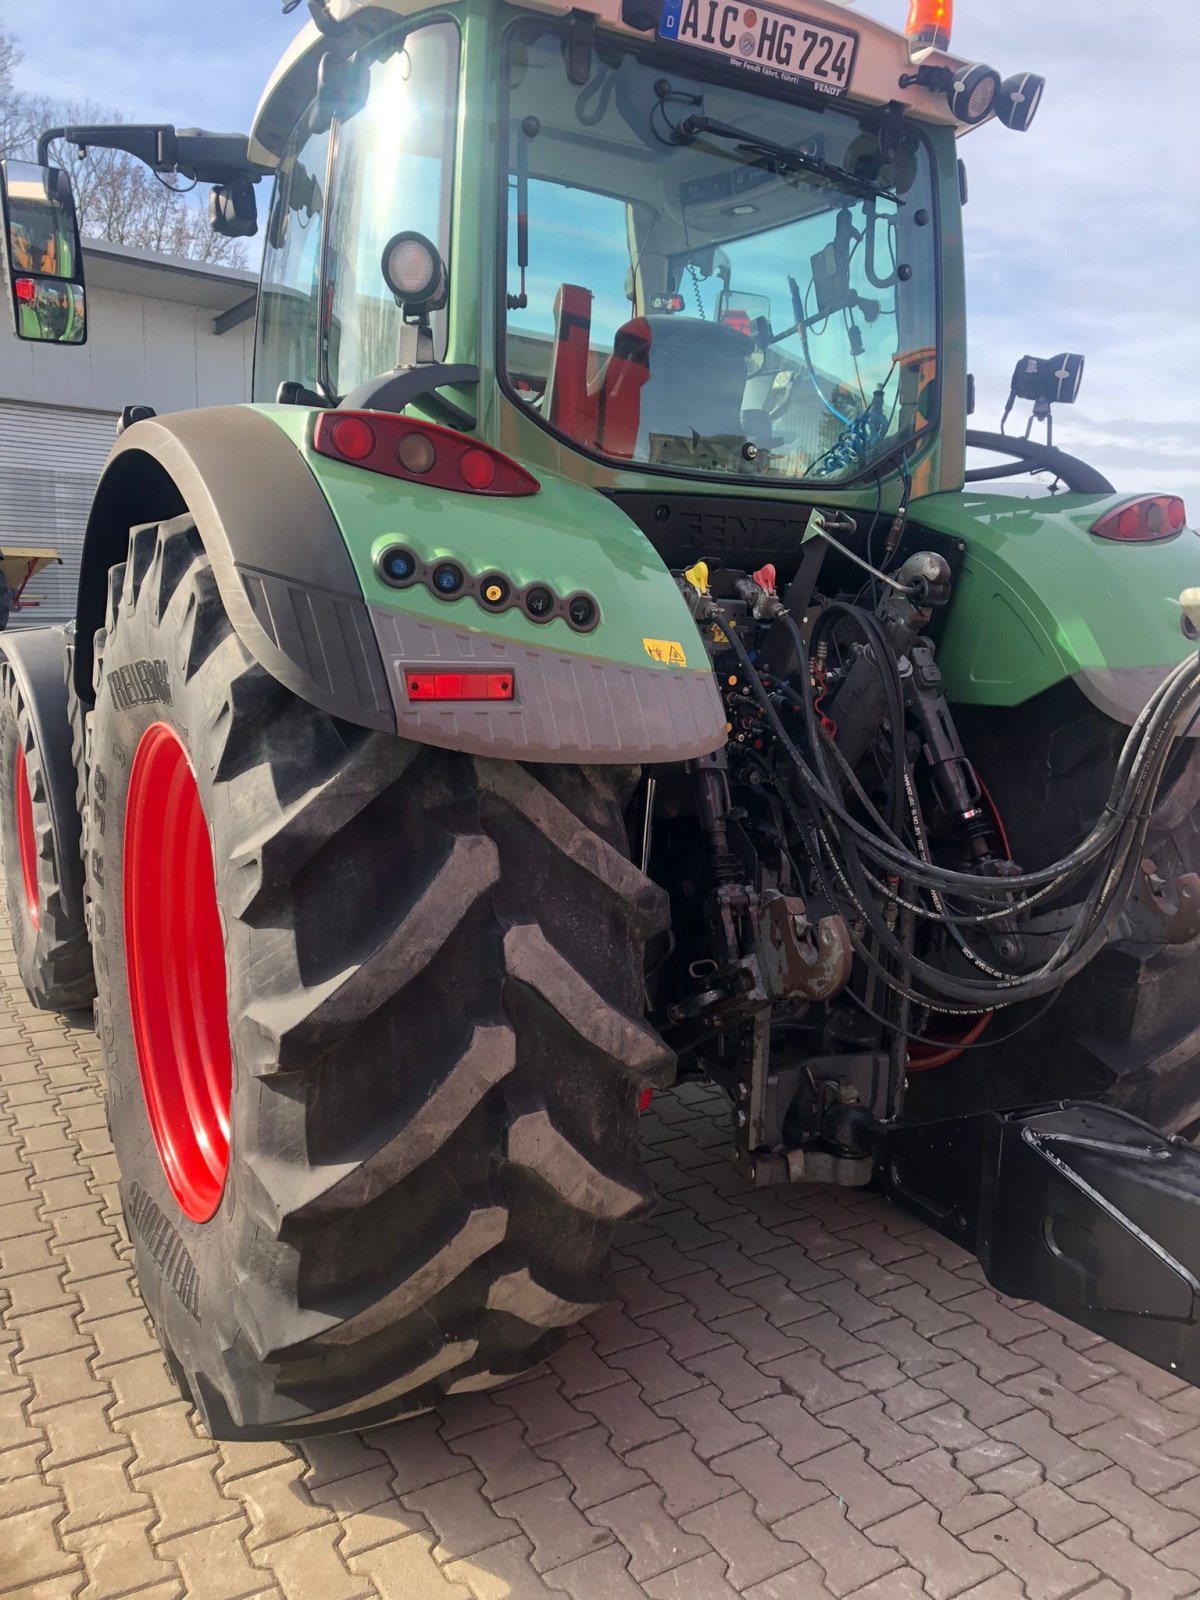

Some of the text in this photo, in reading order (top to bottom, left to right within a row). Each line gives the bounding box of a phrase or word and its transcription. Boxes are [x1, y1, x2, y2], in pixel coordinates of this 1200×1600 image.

[666, 15, 674, 28] D
[681, 0, 847, 82] AIC HG 724
[730, 57, 799, 84] Wer Fendt fährt, führt!
[814, 82, 842, 97] FENDT
